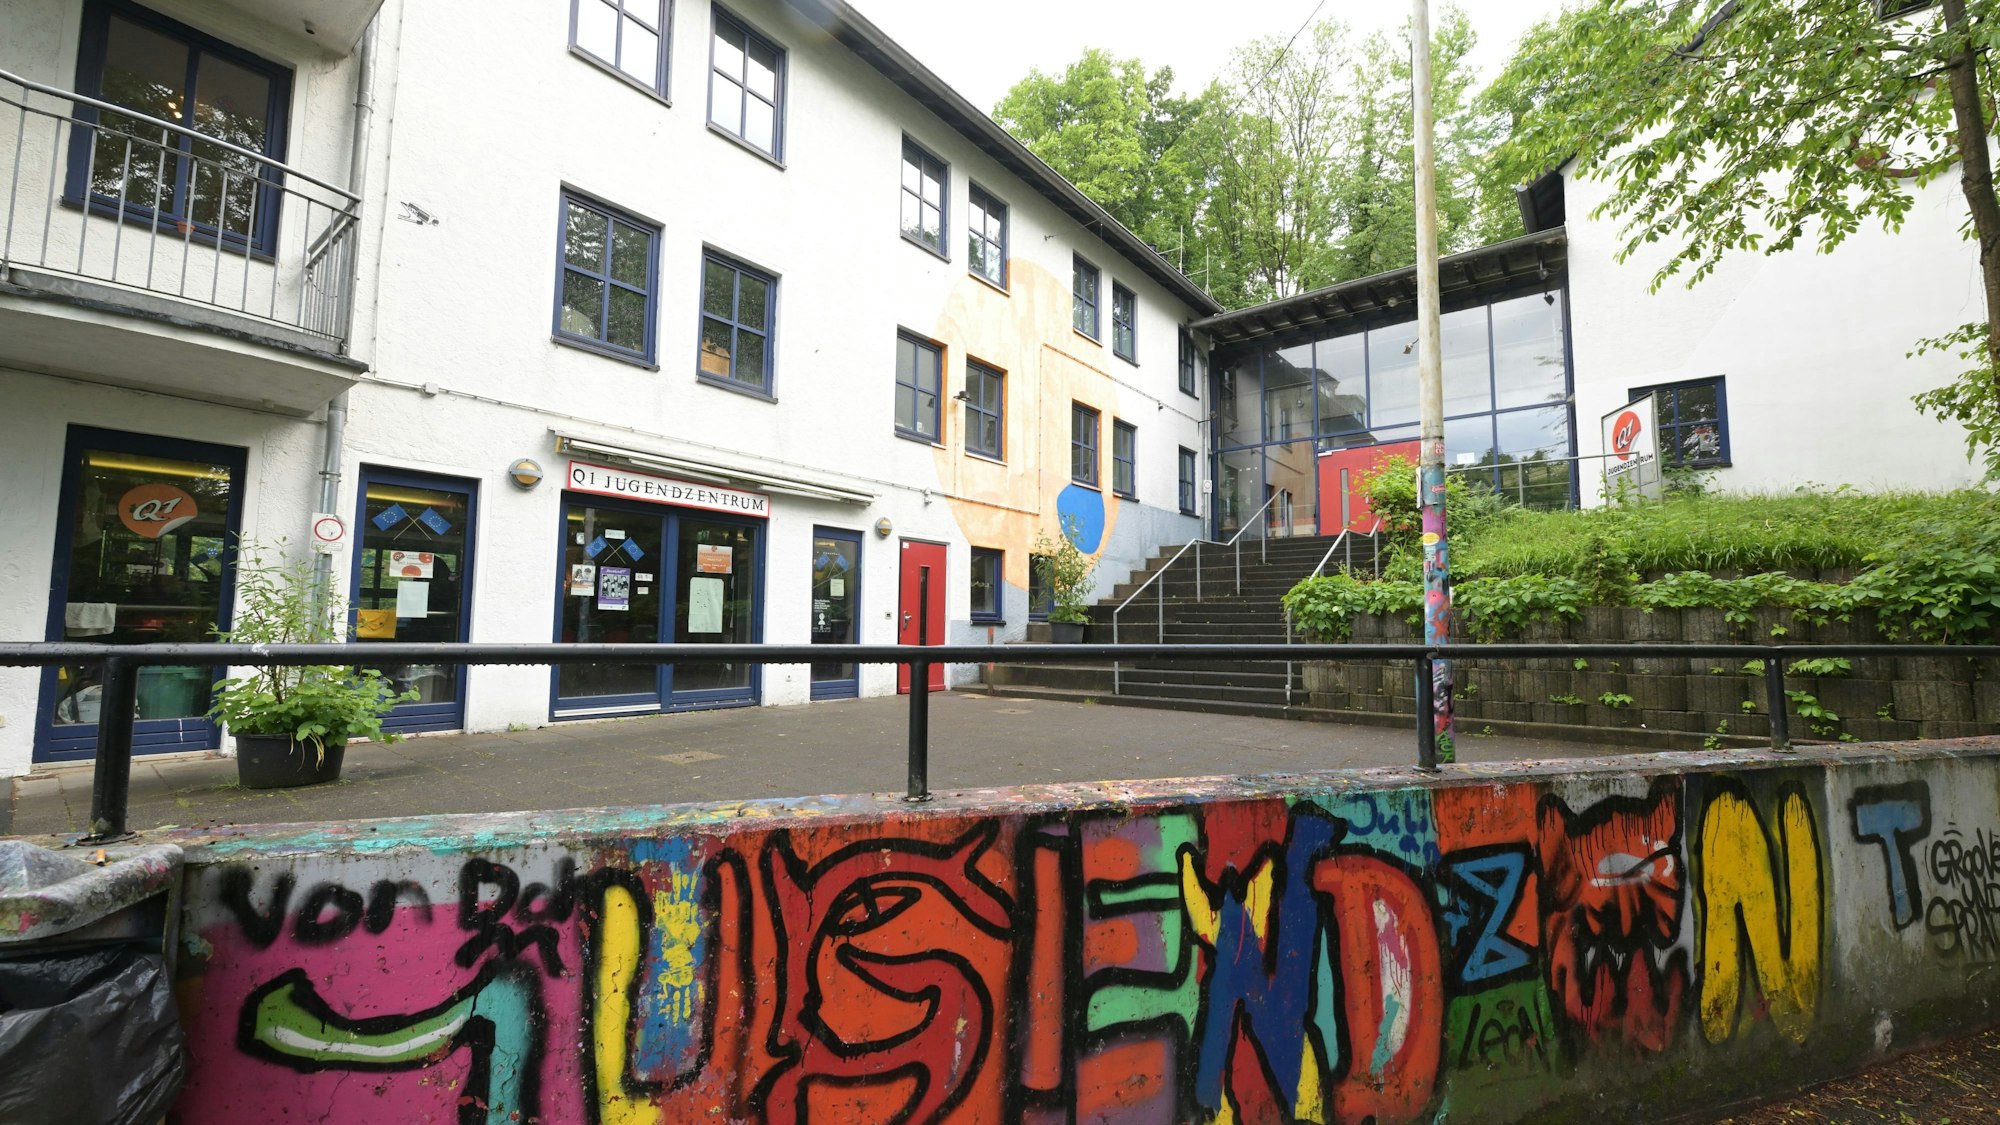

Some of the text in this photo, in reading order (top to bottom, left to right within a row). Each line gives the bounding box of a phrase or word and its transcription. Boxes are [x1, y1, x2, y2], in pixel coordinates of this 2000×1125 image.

[1607, 453, 1654, 475] JUGENDZENRUM
[572, 468, 765, 511] Q1 JUGENDZENTRUM
[131, 496, 184, 522] Q1
